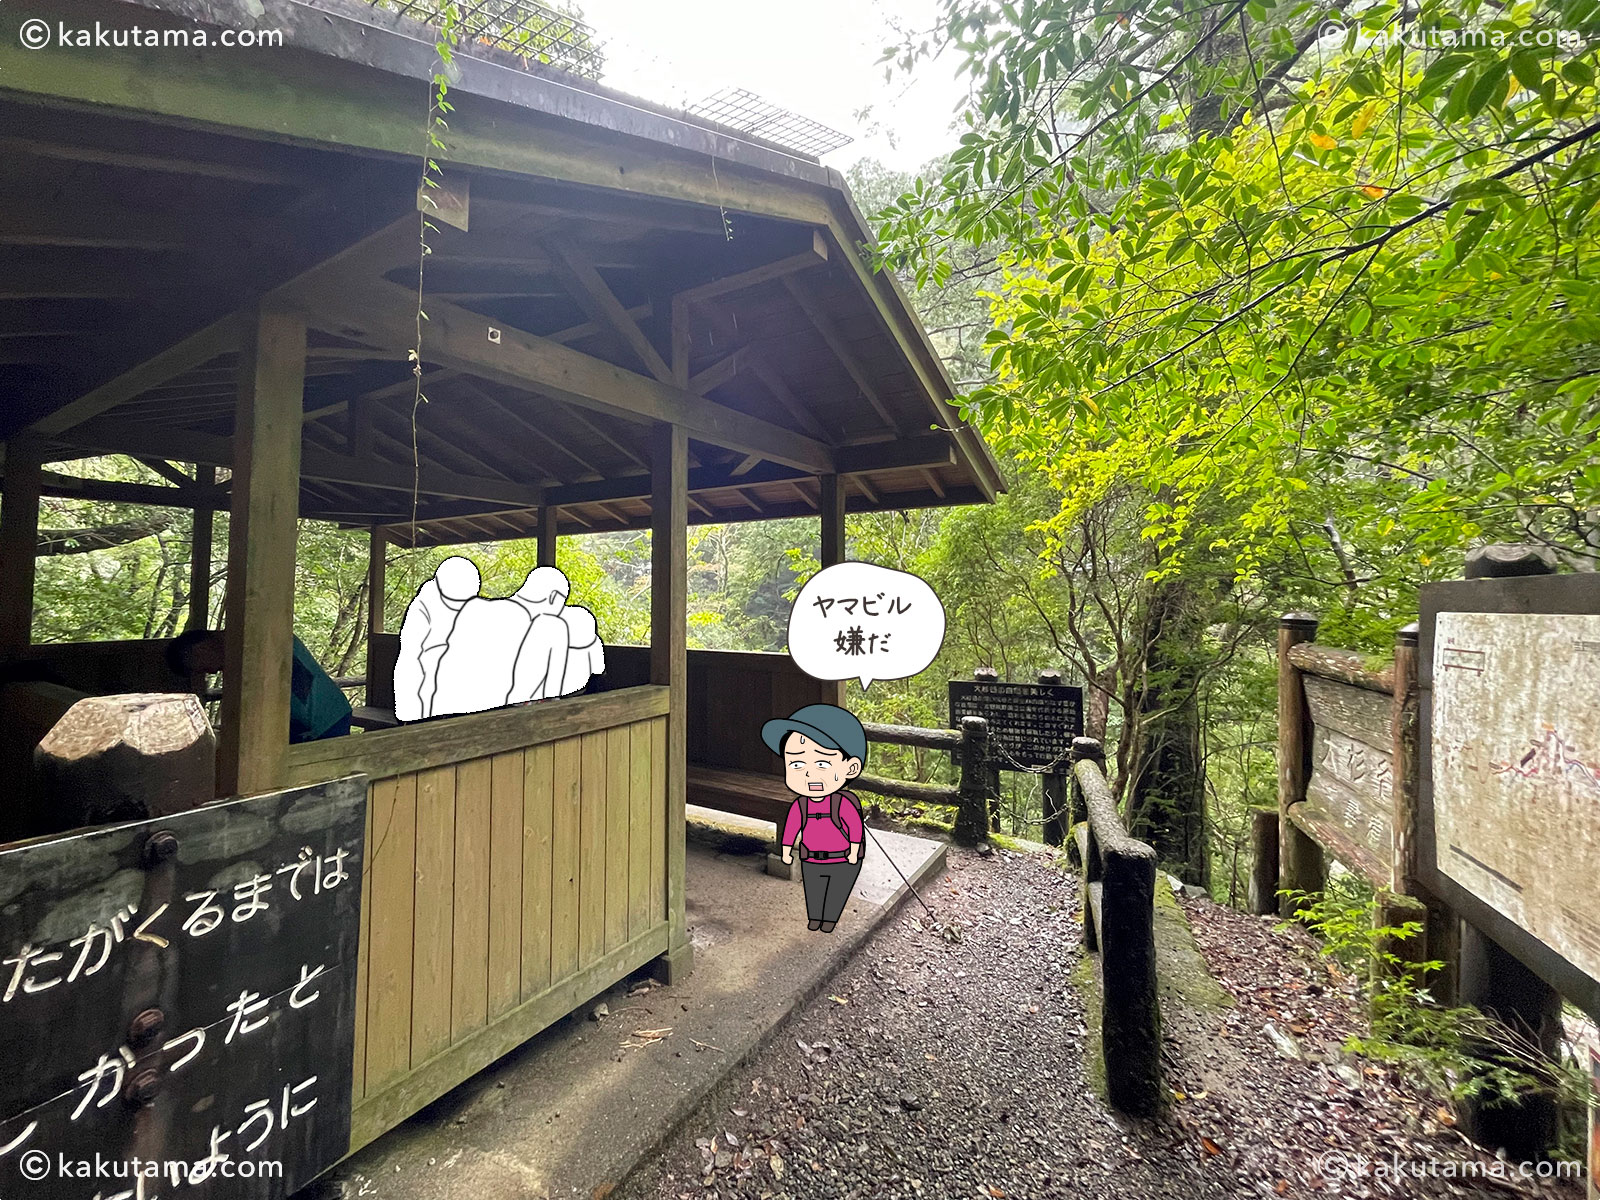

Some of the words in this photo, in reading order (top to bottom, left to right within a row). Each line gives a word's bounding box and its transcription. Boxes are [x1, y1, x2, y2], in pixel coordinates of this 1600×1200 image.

[2, 845, 351, 1002] たがくるまでは
